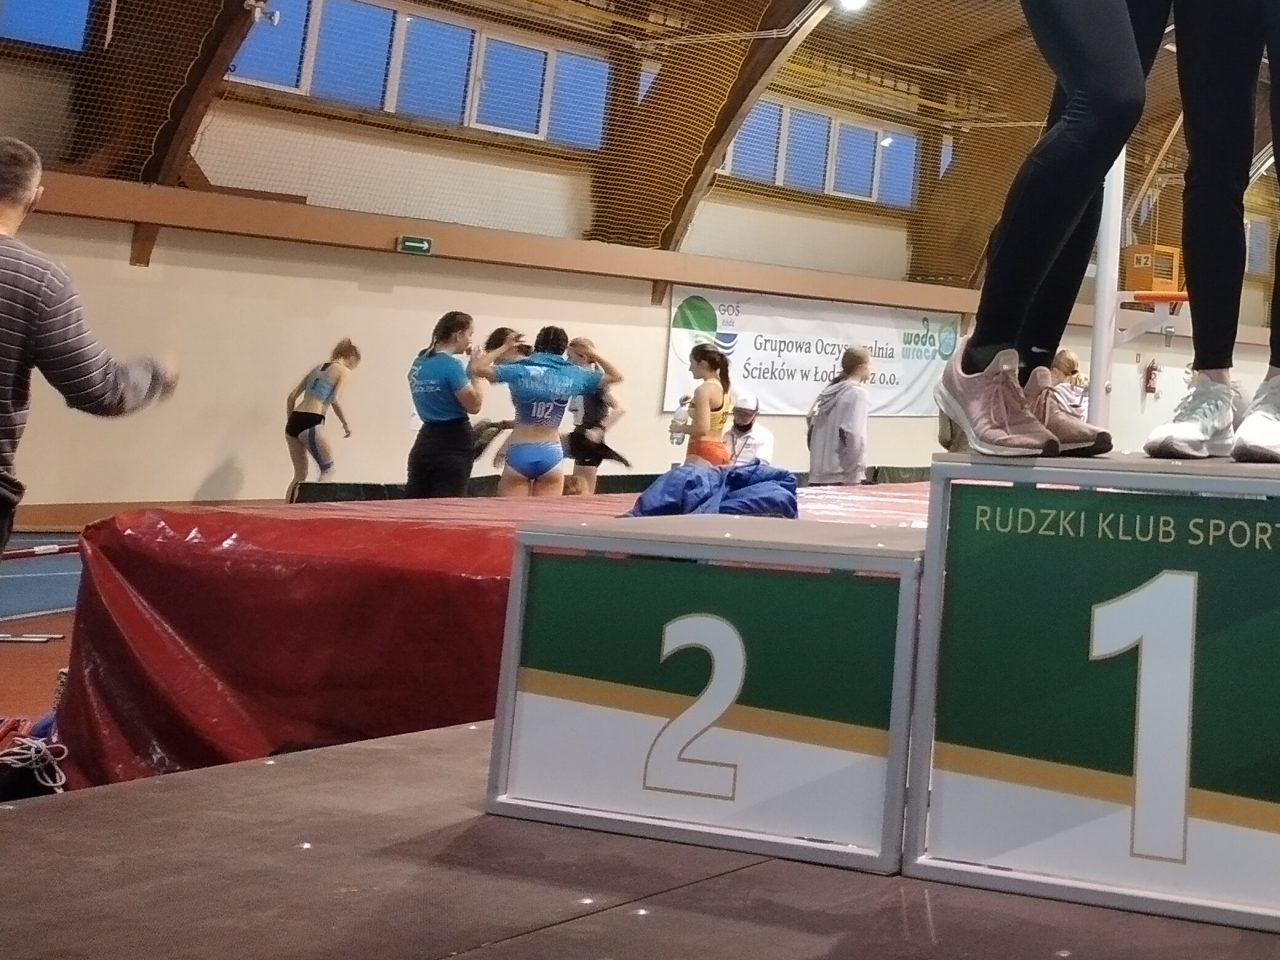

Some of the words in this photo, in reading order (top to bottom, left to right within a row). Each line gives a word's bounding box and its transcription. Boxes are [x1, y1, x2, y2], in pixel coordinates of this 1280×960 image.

[718, 302, 741, 317] GOŚ
[754, 334, 812, 357] Grupowa
[902, 316, 936, 347] woda
[742, 357, 797, 381] Ścieków
[800, 369, 811, 382] w
[879, 373, 900, 386] o.o.
[531, 401, 554, 419] 102
[975, 505, 1085, 537] RUDZKI
[1098, 513, 1176, 543] KLUB
[642, 613, 747, 801] 2
[1089, 569, 1199, 865] 1
